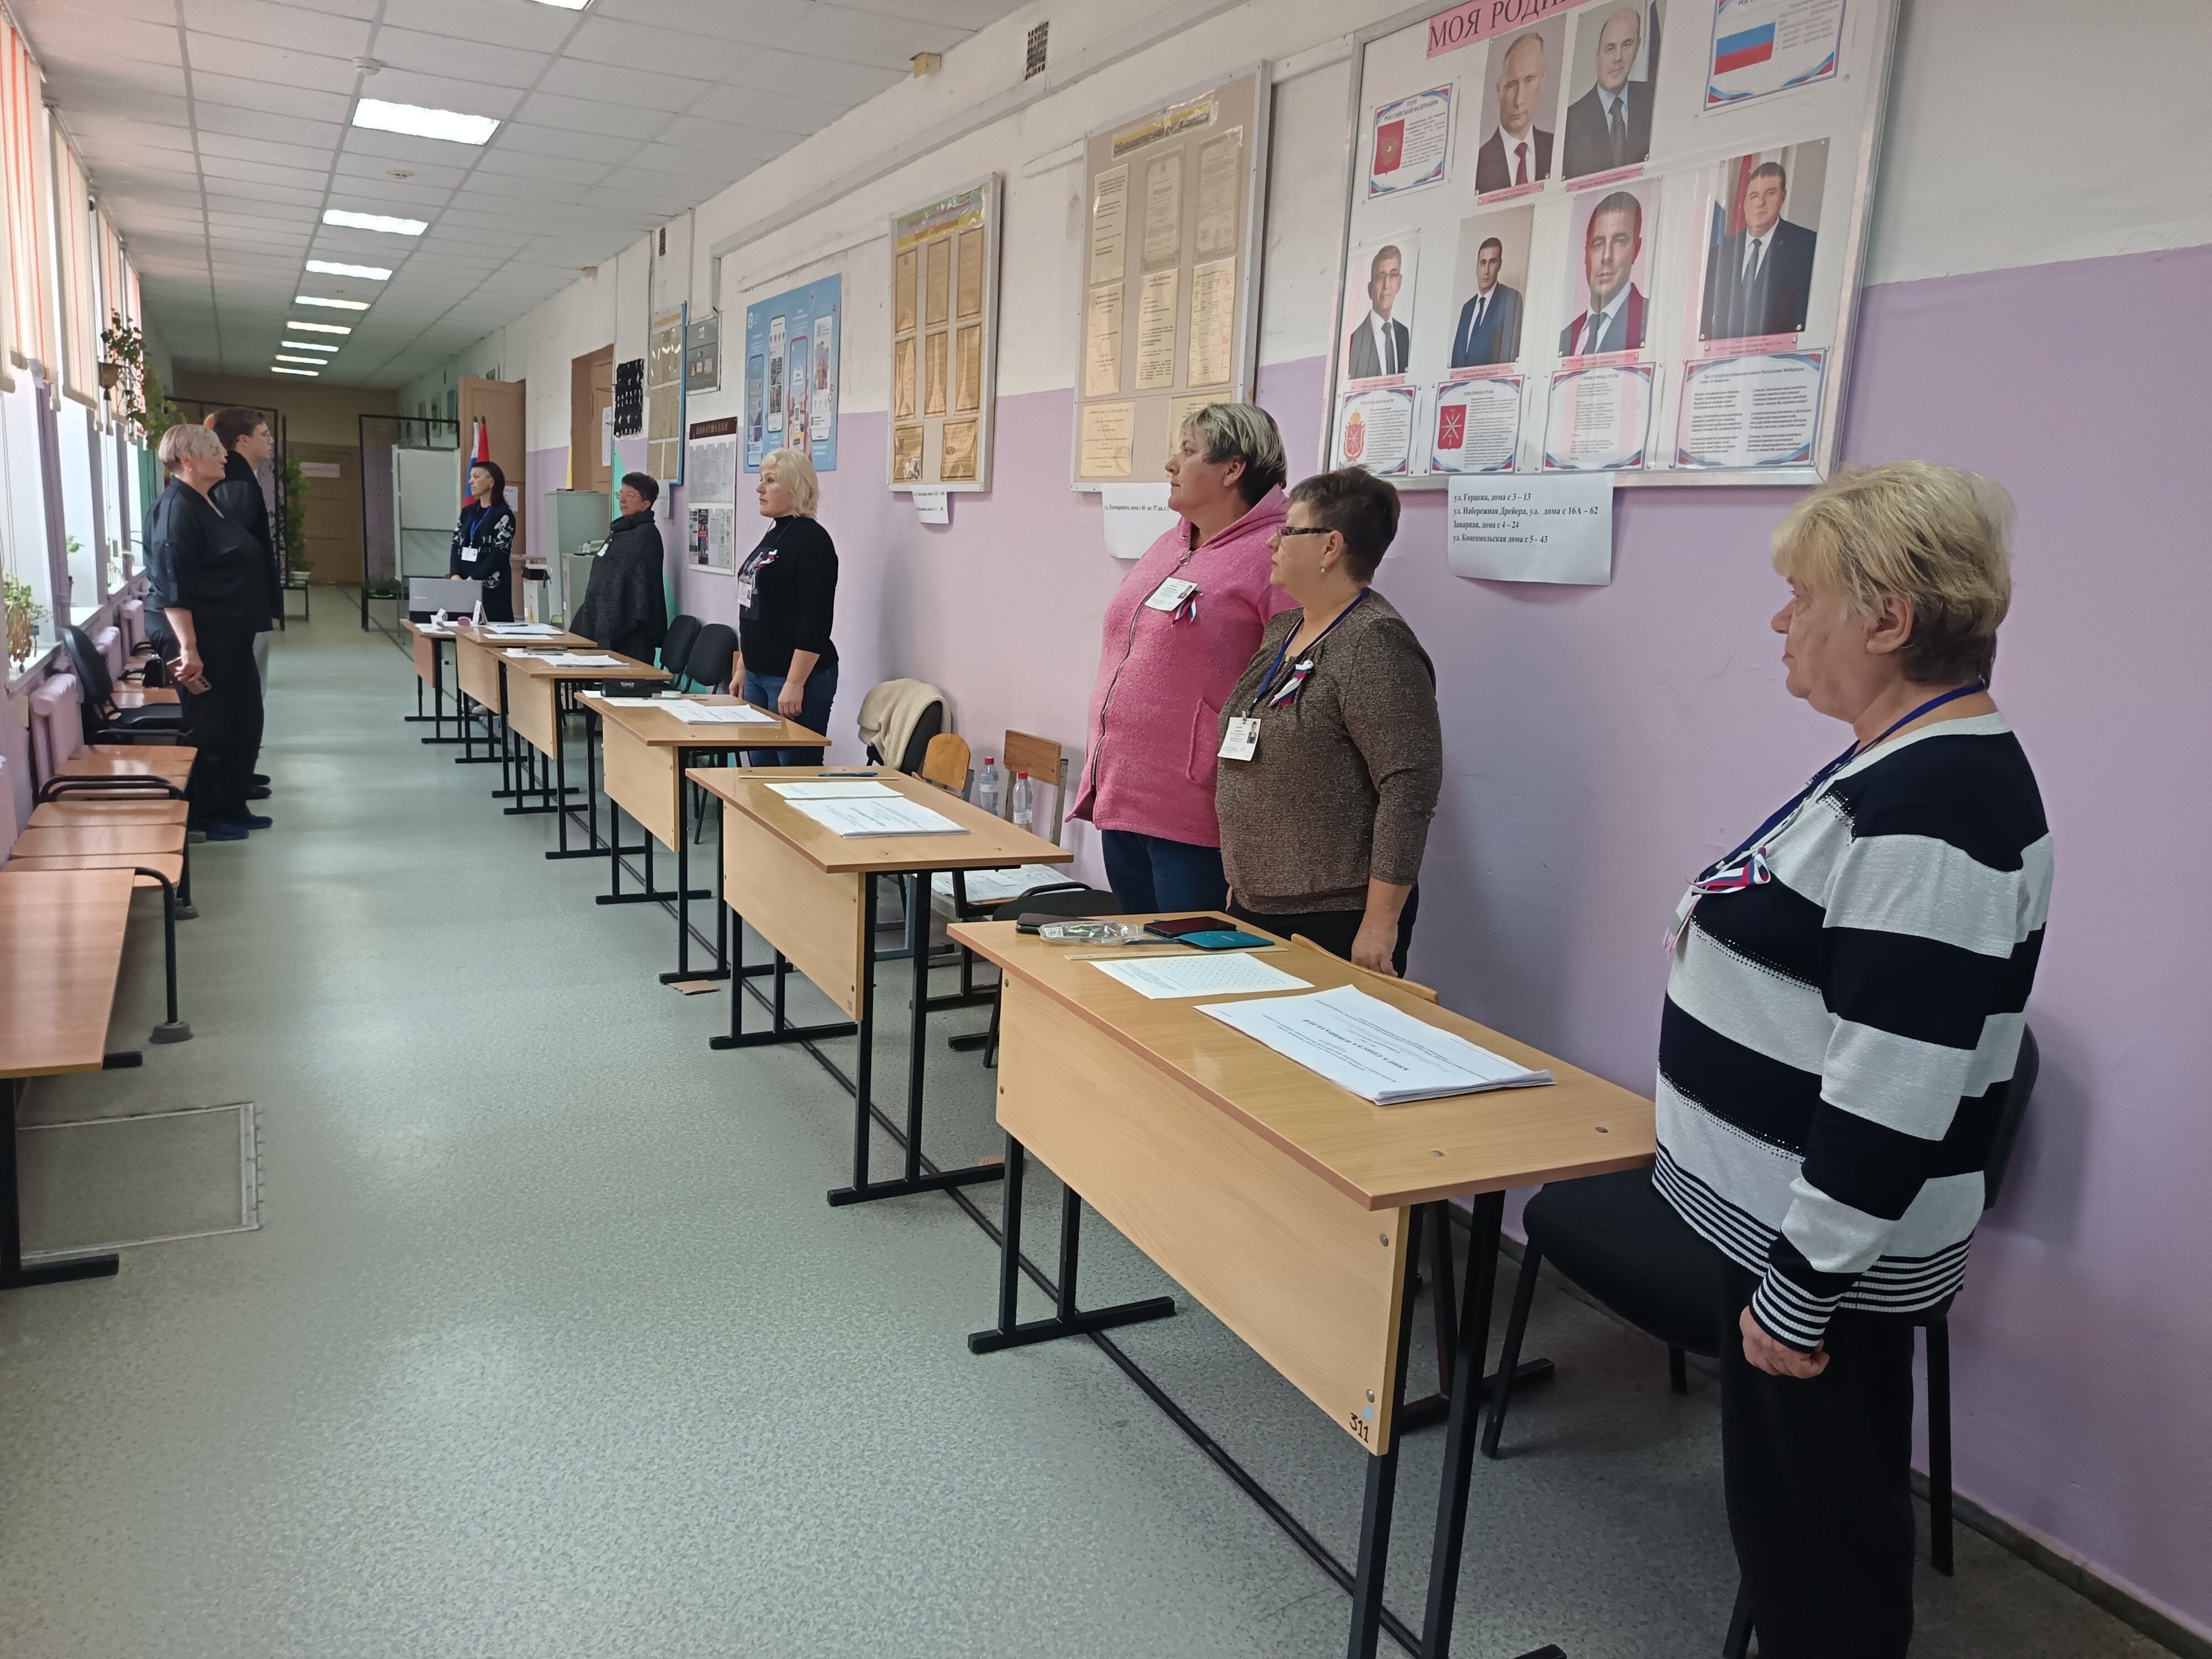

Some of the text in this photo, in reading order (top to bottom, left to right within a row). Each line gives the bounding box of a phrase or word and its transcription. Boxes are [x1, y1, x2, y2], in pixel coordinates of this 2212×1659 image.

[1428, 8, 1481, 51] МОЯ
[696, 422, 728, 435] ИНФОРМАЦИЯ
[1464, 494, 1490, 503] Герцена,
[1463, 507, 1498, 516] Набережная
[1499, 507, 1528, 517] Дрейера,
[1568, 507, 1581, 515] 16А
[1589, 507, 1598, 515] 62
[1453, 521, 1480, 530] Заварная,
[1302, 1019, 1352, 1042] ИЗБИРАТЕЛЕЙ
[1352, 1042, 1382, 1057] СПИСКА
[1383, 1057, 1409, 1070] КНИГА
[1350, 1412, 1369, 1443] 311
